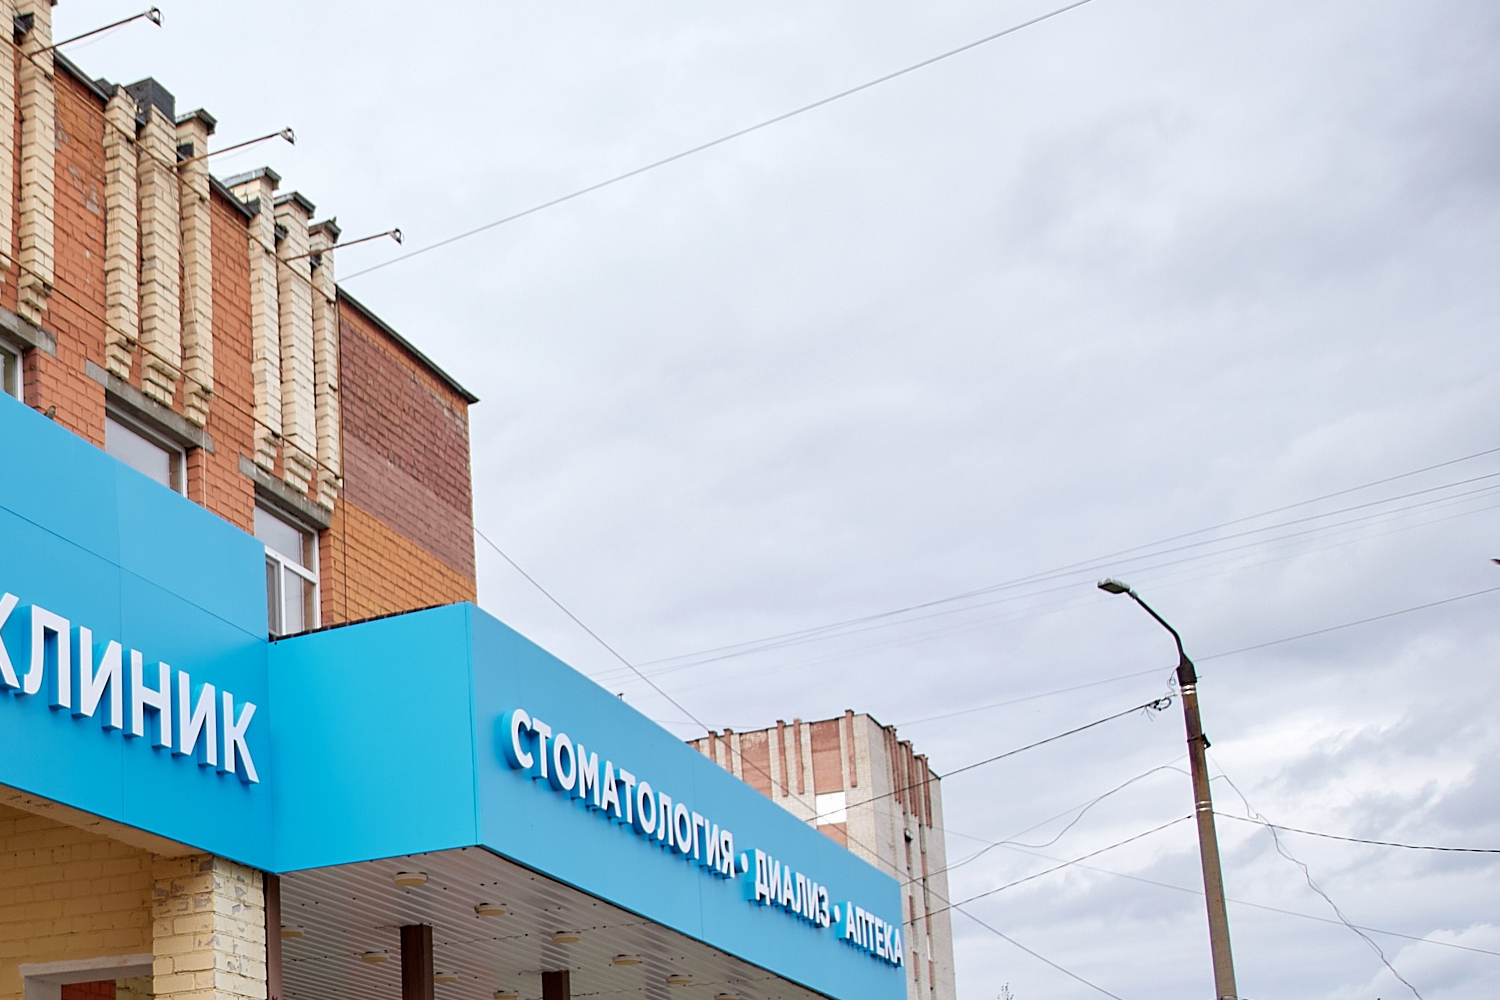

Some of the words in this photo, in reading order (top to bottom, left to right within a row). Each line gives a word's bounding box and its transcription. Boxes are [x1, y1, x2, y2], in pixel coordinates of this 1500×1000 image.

[507, 708, 736, 879] СТОМАТОЛОГИЯ
[750, 847, 831, 929] ДИАЛИЗ
[843, 900, 905, 968] АПТЕКА
